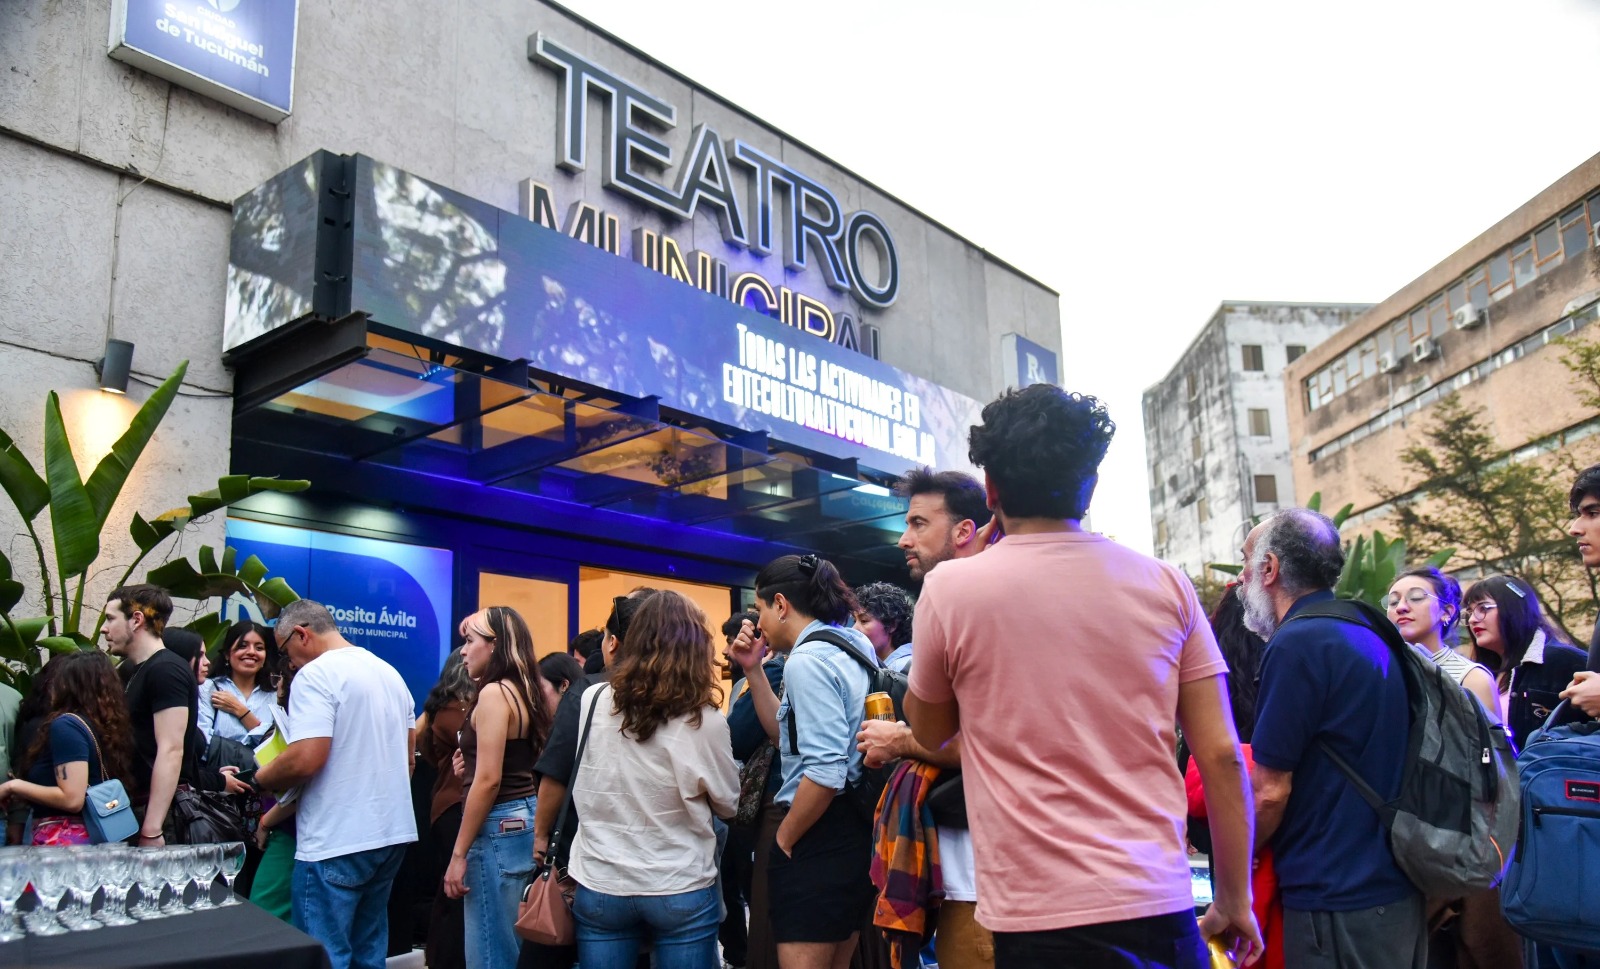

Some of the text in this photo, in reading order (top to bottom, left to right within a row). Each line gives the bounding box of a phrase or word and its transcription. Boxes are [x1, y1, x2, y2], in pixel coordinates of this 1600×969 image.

[164, 2, 264, 59] San Miguel
[197, 6, 236, 29] CIUDAD
[156, 18, 269, 77] de Tucumán
[527, 30, 900, 309] TEATRO
[737, 323, 786, 380] TODAS
[789, 347, 817, 391] LAS
[820, 359, 902, 422] ACTIVIDADES
[325, 604, 417, 628] Rosita Ávila
[336, 625, 408, 639] EATRO MUNICIPAL
